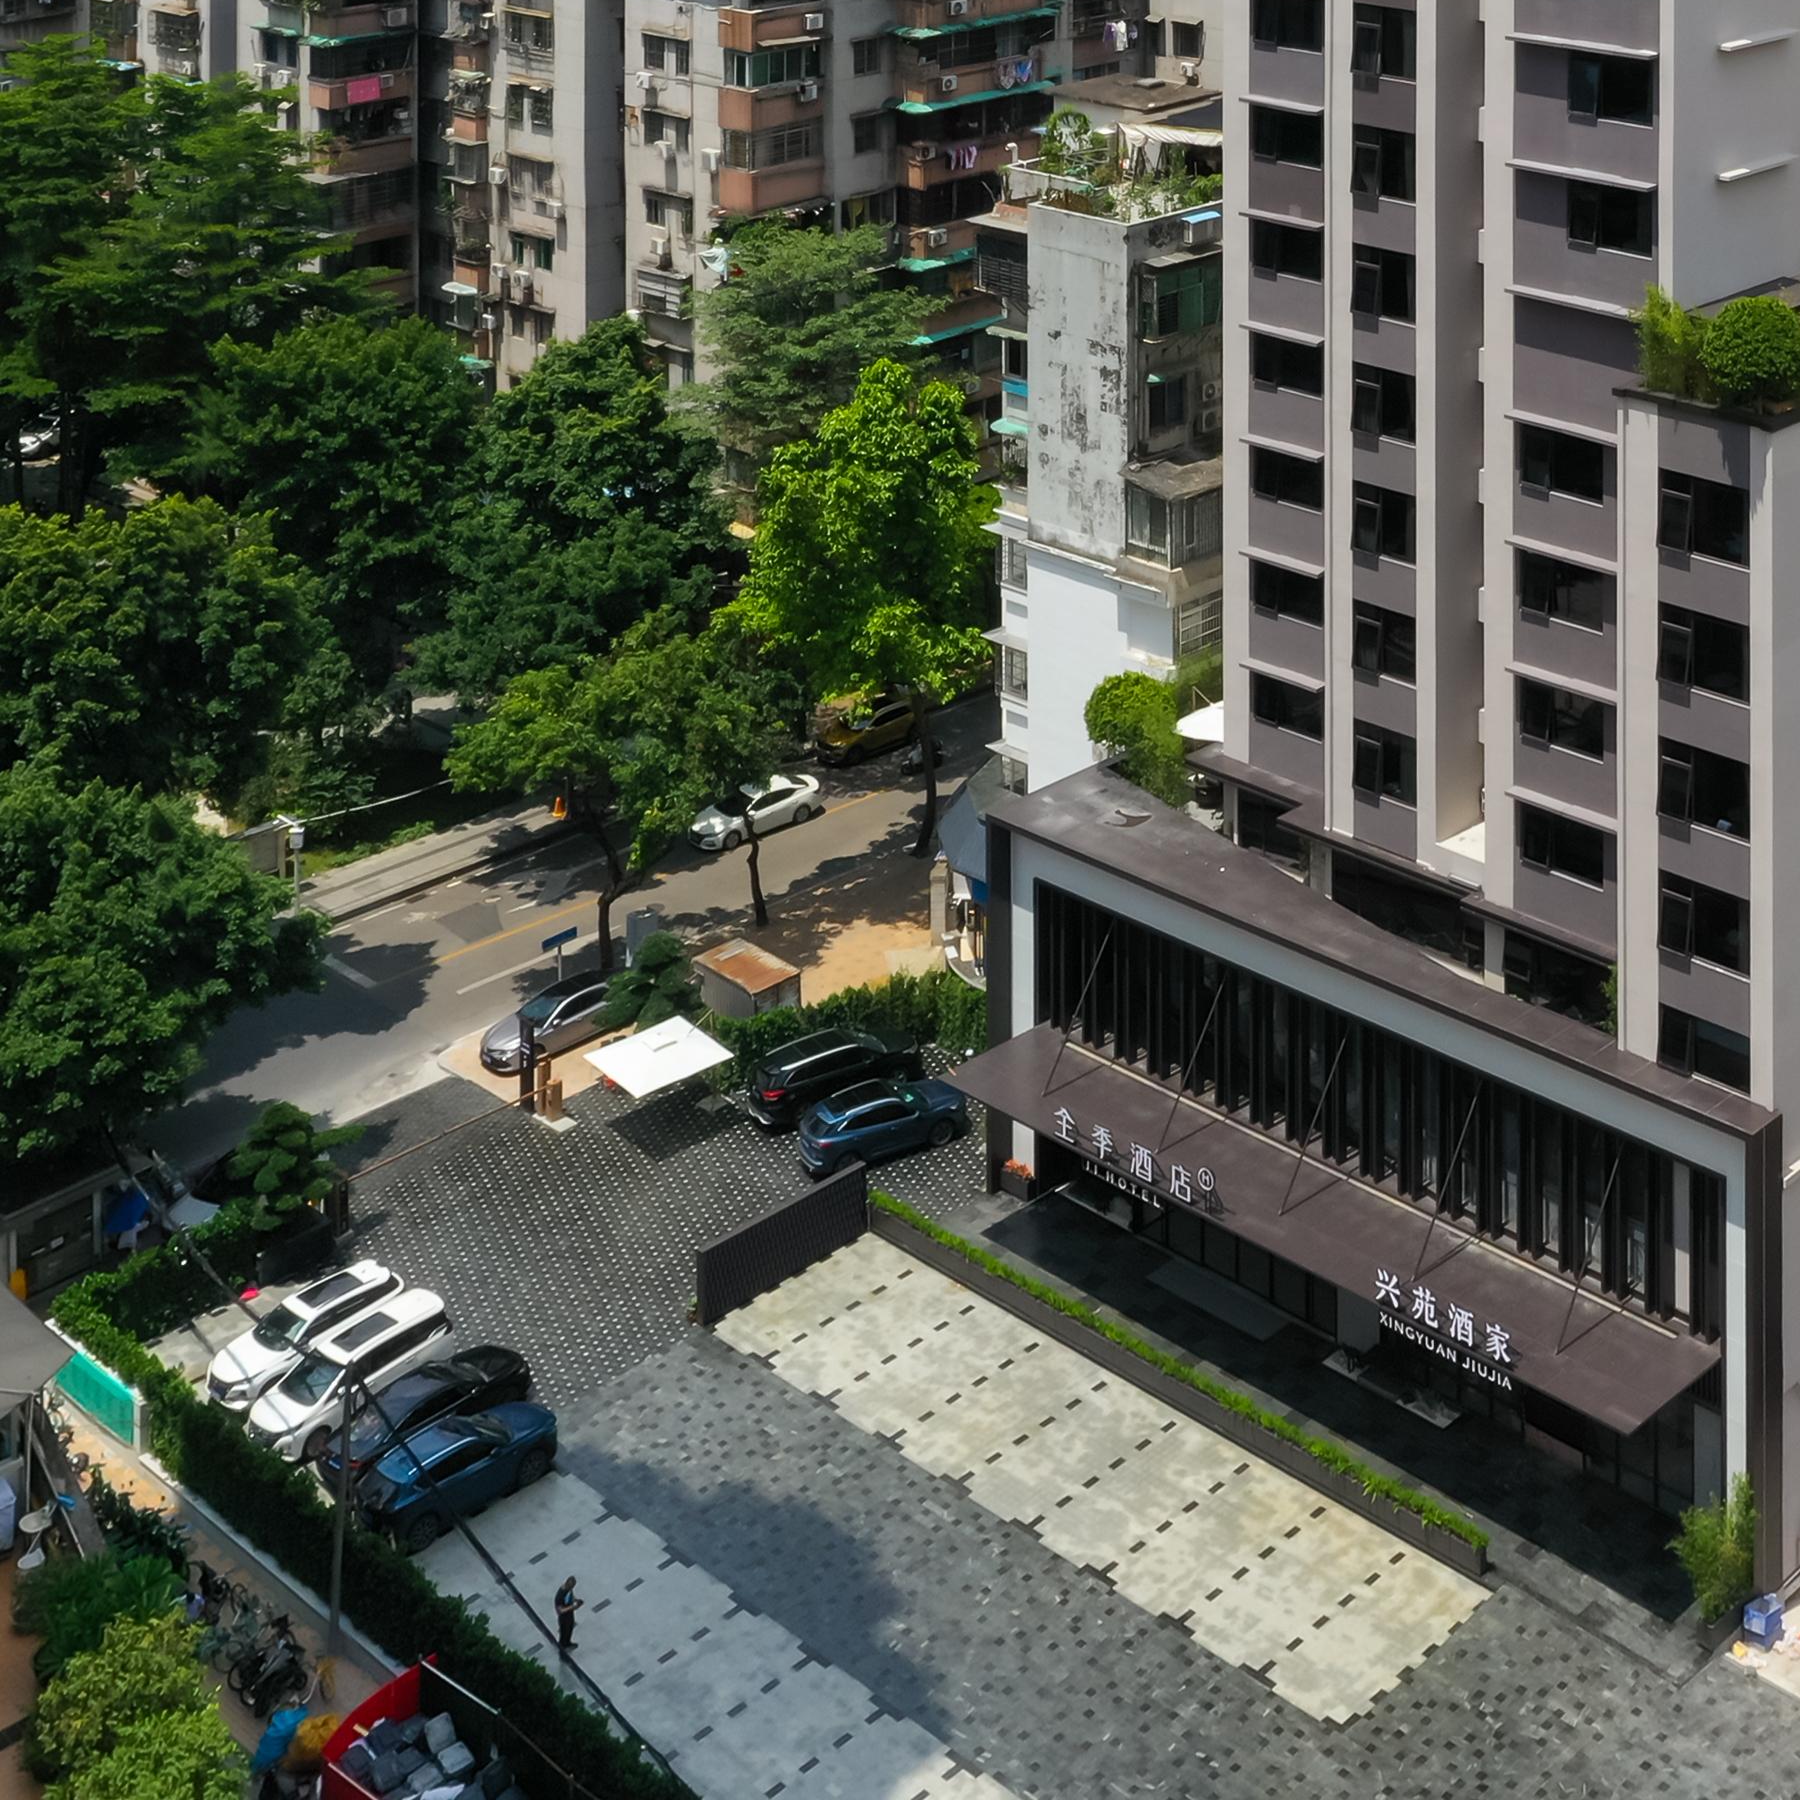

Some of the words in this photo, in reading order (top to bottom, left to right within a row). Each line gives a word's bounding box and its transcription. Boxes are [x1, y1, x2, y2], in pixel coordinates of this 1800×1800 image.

[1053, 1106, 1192, 1204] 全季酒店
[1105, 1170, 1162, 1209] HOTEL
[1375, 1267, 1512, 1363] 兴苑酒家
[1379, 1311, 1457, 1363] XINGYUAN
[1462, 1356, 1513, 1391] JIUJIA
